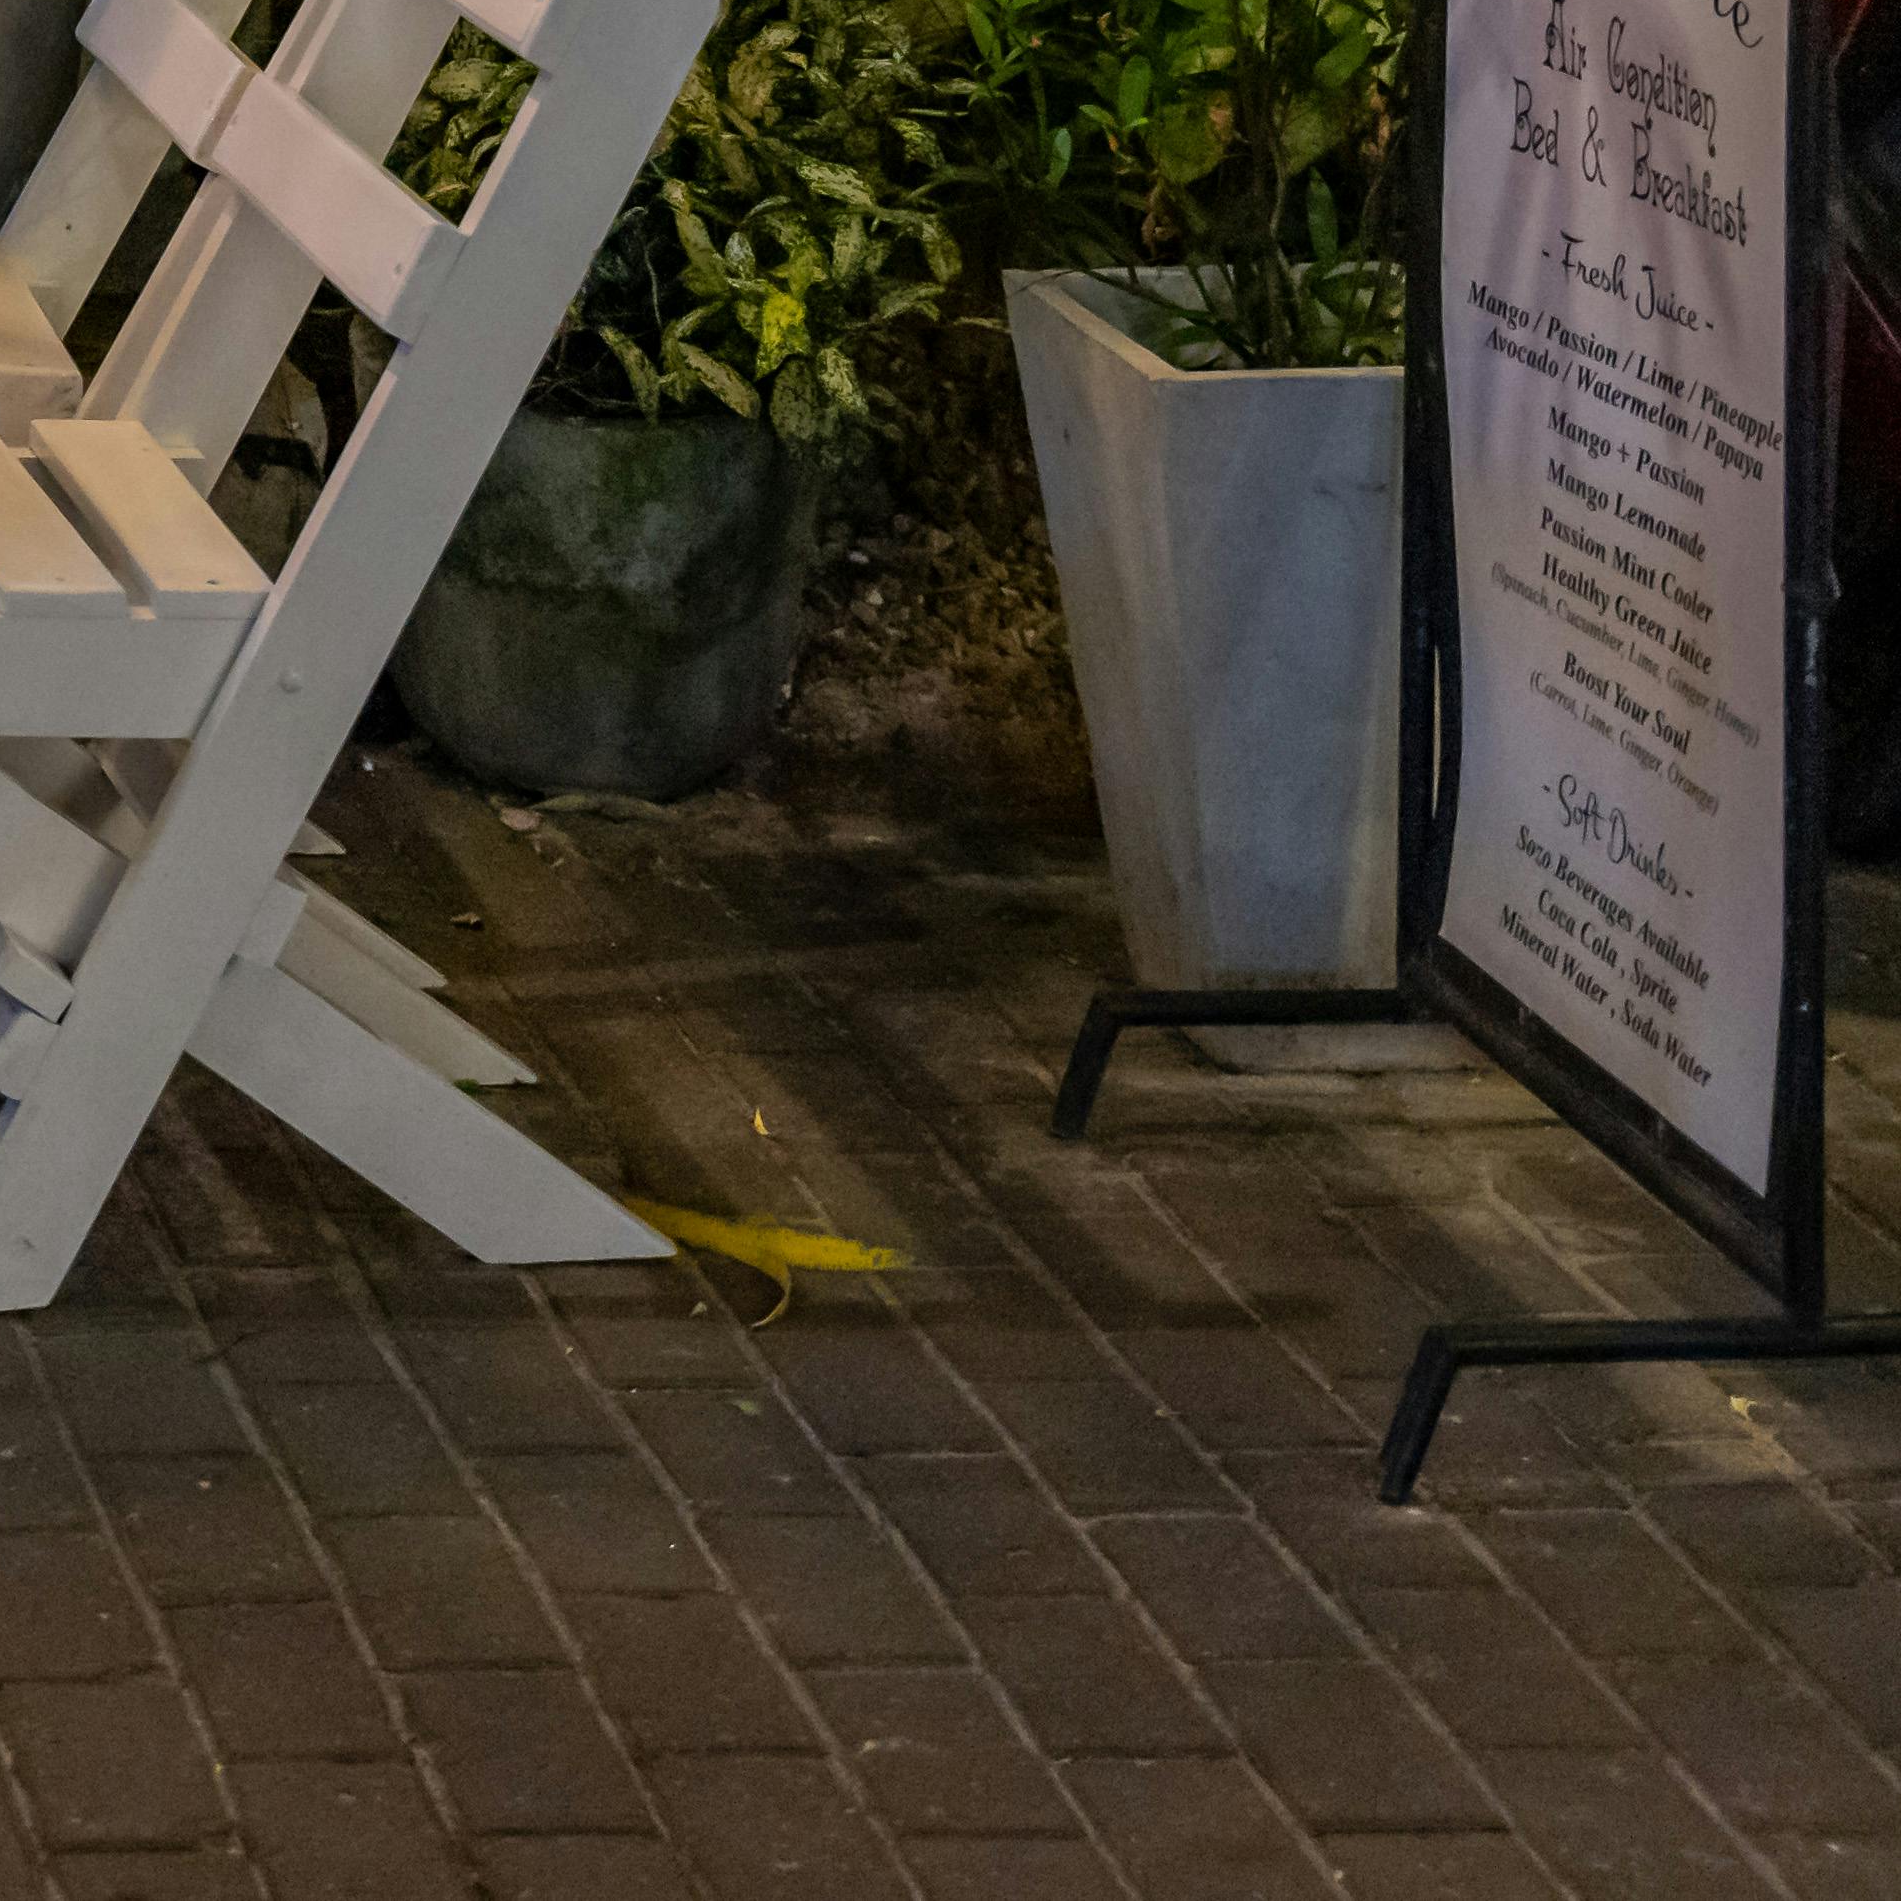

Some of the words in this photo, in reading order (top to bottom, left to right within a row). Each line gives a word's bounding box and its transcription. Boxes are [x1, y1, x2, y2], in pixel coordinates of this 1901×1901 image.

[1607, 15, 1716, 158] Condition
[1511, 76, 1559, 168] Bed
[1581, 104, 1607, 187] &
[1630, 114, 1747, 250] Breakfast
[1560, 229, 1629, 302] Fresh
[1635, 264, 1699, 333] Juice
[1467, 280, 1531, 330] Mango
[1546, 315, 1618, 370] Passion
[1637, 353, 1687, 398] Lime
[1701, 384, 1783, 453] Pineapple
[1485, 326, 1559, 382] Avocado
[1575, 364, 1690, 441] Watermelon
[1703, 428, 1765, 484] Papaya
[1547, 406, 1613, 460] Mango
[1635, 444, 1706, 506] Passion
[1547, 456, 1611, 512] Mango
[1614, 487, 1708, 563] Lemonade
[1539, 506, 1608, 565] Passion
[1611, 543, 1657, 591] Mint
[1660, 570, 1715, 626] Cooler
[1542, 551, 1611, 618] Healthy
[1614, 594, 1667, 646] Green
[1668, 625, 1713, 676] Juice
[1562, 650, 1611, 700] Boost
[1613, 689, 1651, 728] Your
[1654, 708, 1691, 755] Soul
[1557, 773, 1606, 845] Soft
[1607, 807, 1678, 898] Drinks
[1538, 888, 1577, 938] Coca
[1580, 919, 1619, 966] Cola
[1634, 956, 1679, 1016] Sprite
[1557, 853, 1635, 932] Beverages
[1637, 920, 1710, 991] Available
[1499, 903, 1559, 970] Mineral
[1560, 951, 1609, 1005] Water
[1623, 1002, 1661, 1052] Soda
[1662, 1032, 1713, 1090] Water
